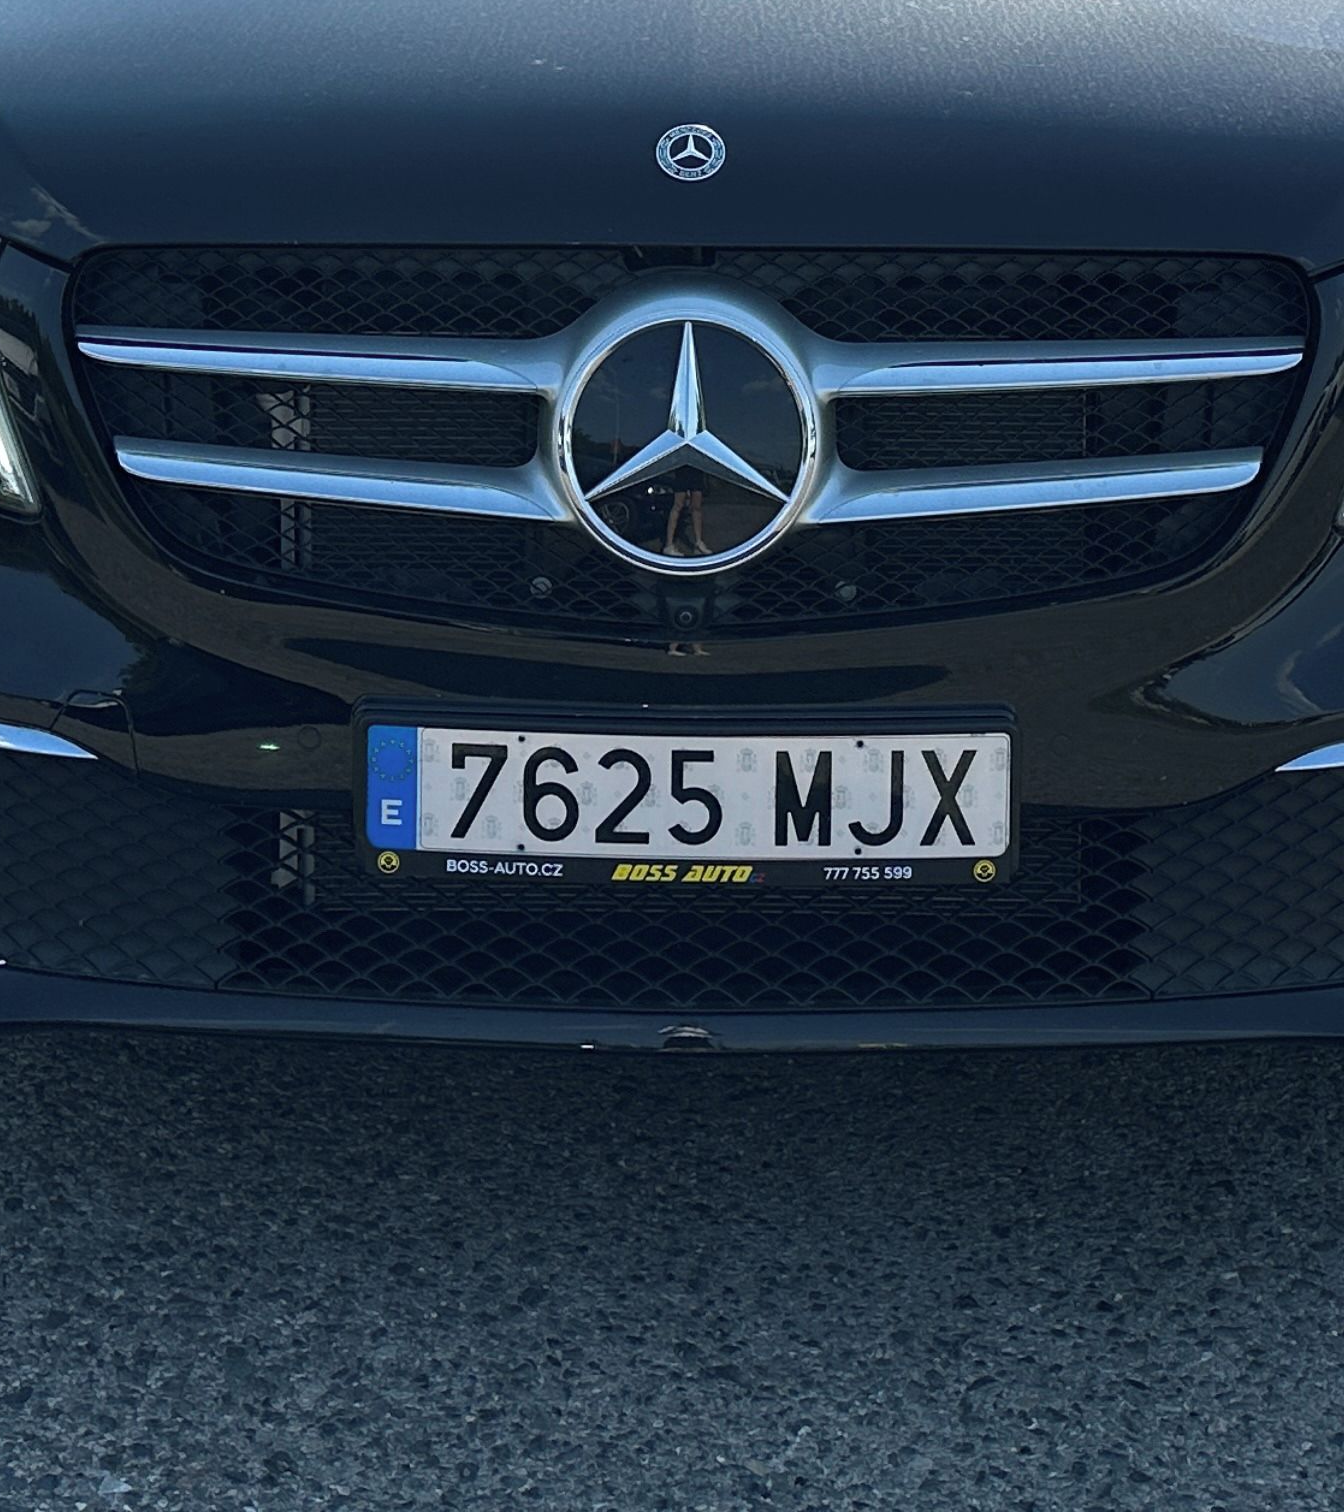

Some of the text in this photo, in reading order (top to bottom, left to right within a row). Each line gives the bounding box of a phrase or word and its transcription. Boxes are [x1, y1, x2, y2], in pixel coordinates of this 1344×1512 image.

[450, 742, 977, 847] 7625 MJX
[381, 799, 403, 826] E
[445, 858, 564, 877] BOSS-AUTO.CZ
[611, 863, 678, 882] BOSS
[681, 864, 753, 883] AUTO
[823, 865, 913, 880] 777 755 599
